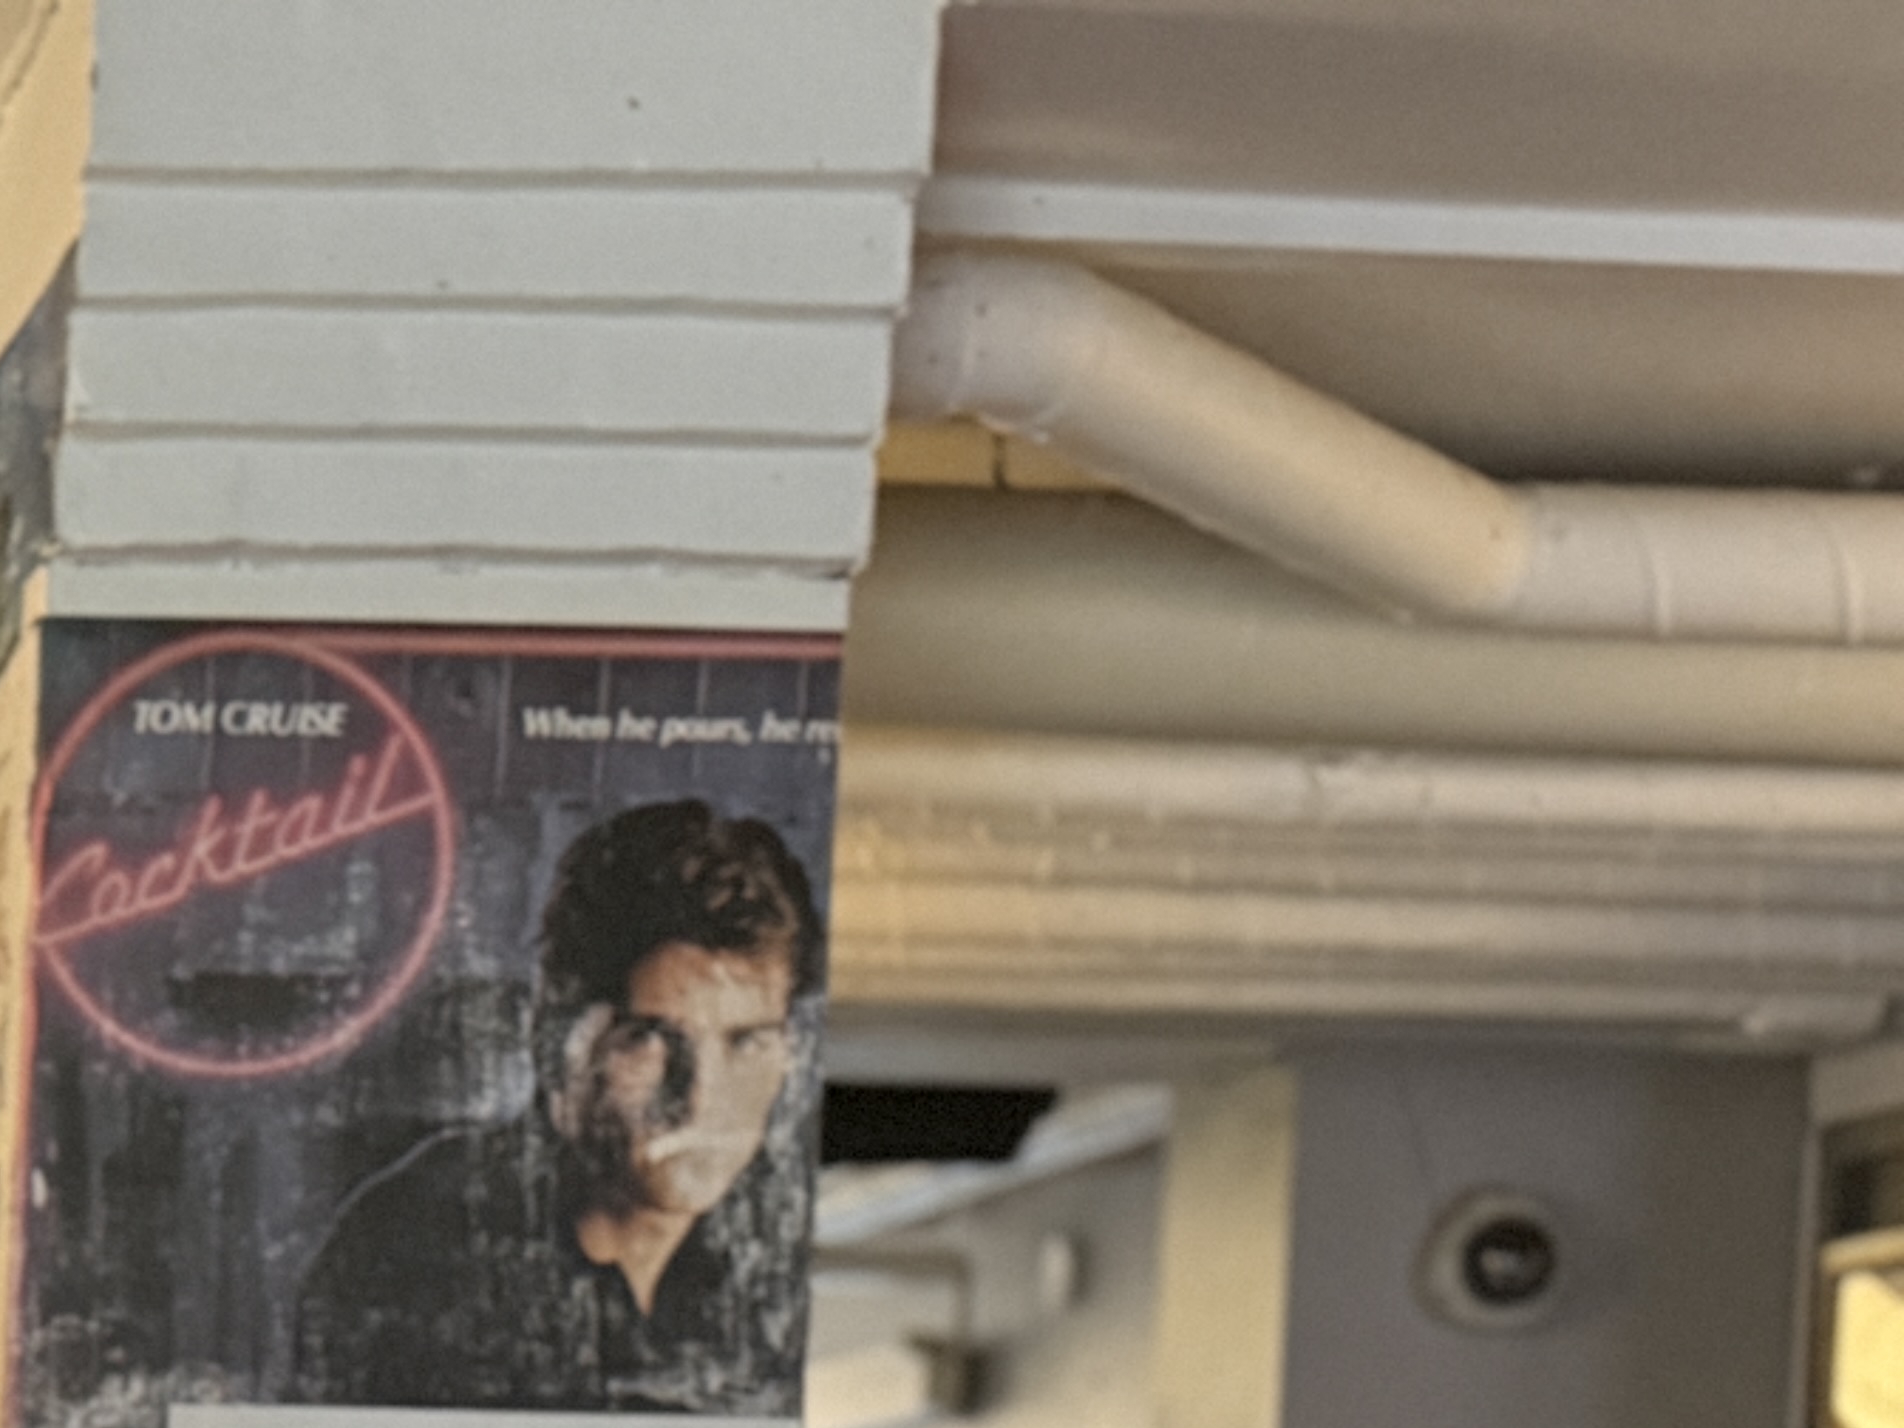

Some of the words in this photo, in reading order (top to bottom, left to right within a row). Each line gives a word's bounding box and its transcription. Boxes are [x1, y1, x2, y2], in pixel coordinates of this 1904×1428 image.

[133, 699, 216, 735] TOM
[219, 700, 349, 738] CRUISE
[523, 706, 613, 740] When
[616, 708, 658, 741] he
[659, 716, 754, 749] pours,
[759, 710, 801, 743] he
[38, 728, 438, 945] Cocktail
